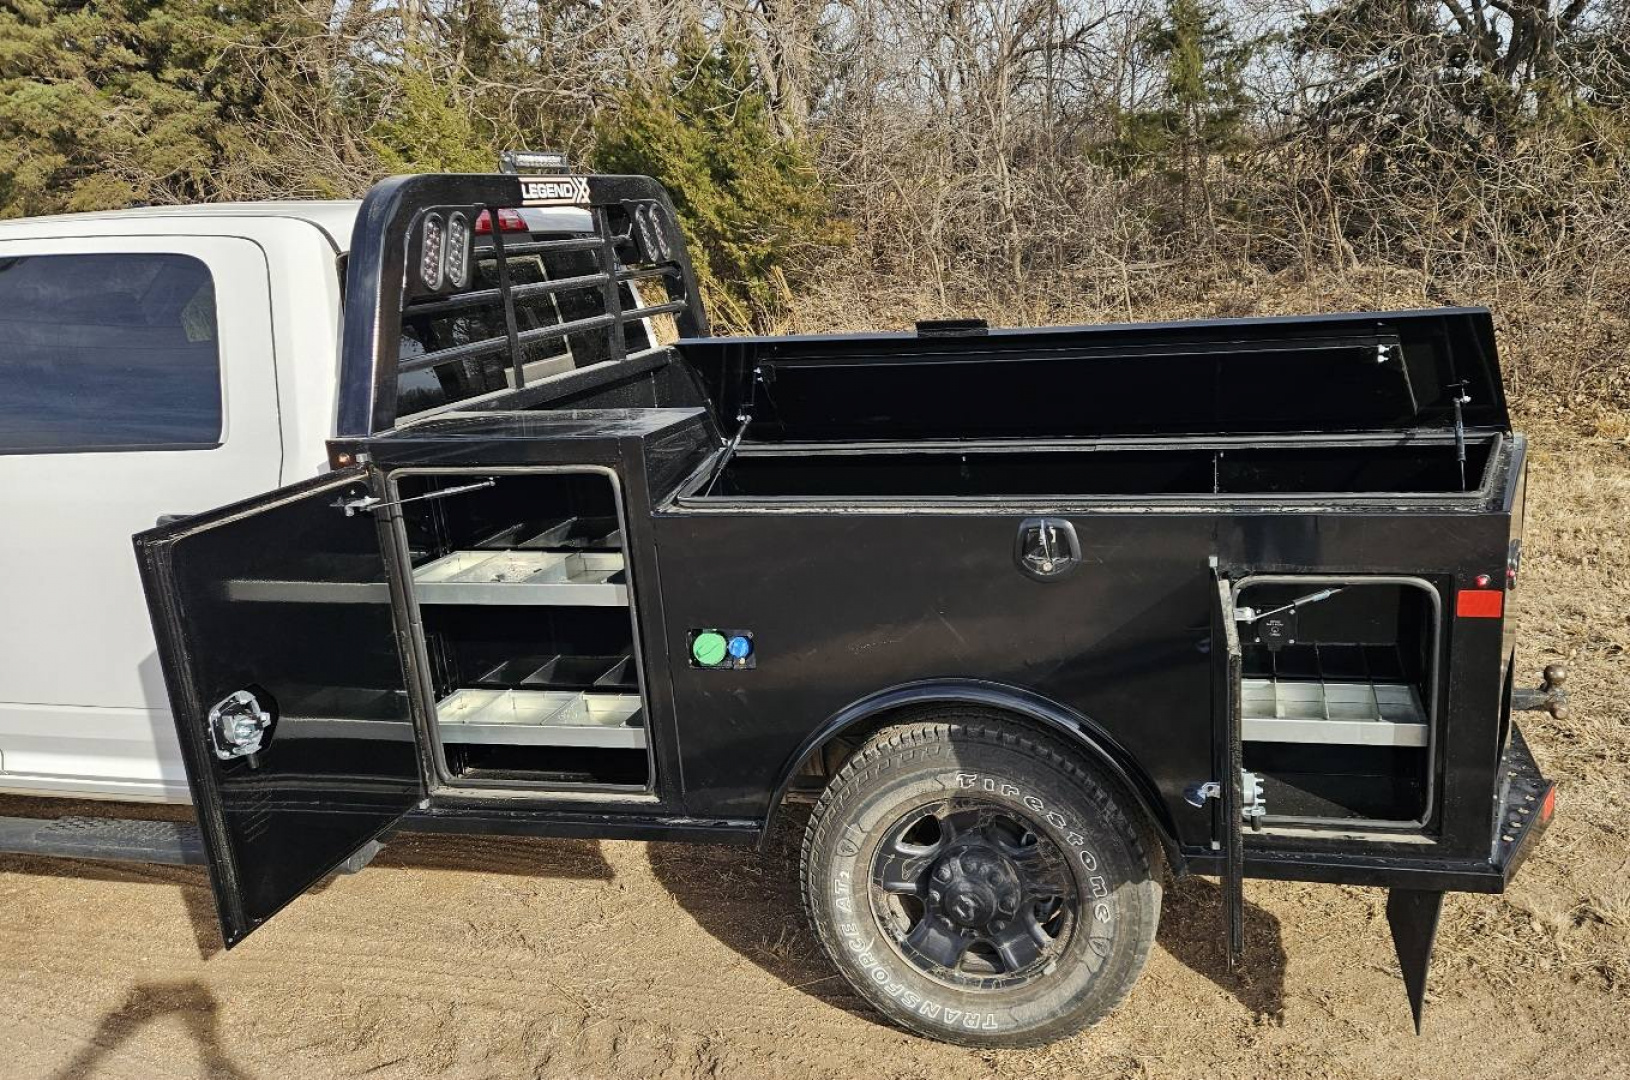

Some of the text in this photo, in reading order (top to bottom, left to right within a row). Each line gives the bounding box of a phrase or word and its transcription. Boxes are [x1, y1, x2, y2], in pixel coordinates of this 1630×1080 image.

[521, 183, 573, 199] LEGEND
[956, 773, 1110, 924] Firestone
[841, 922, 999, 1030] TRANSFORCE
